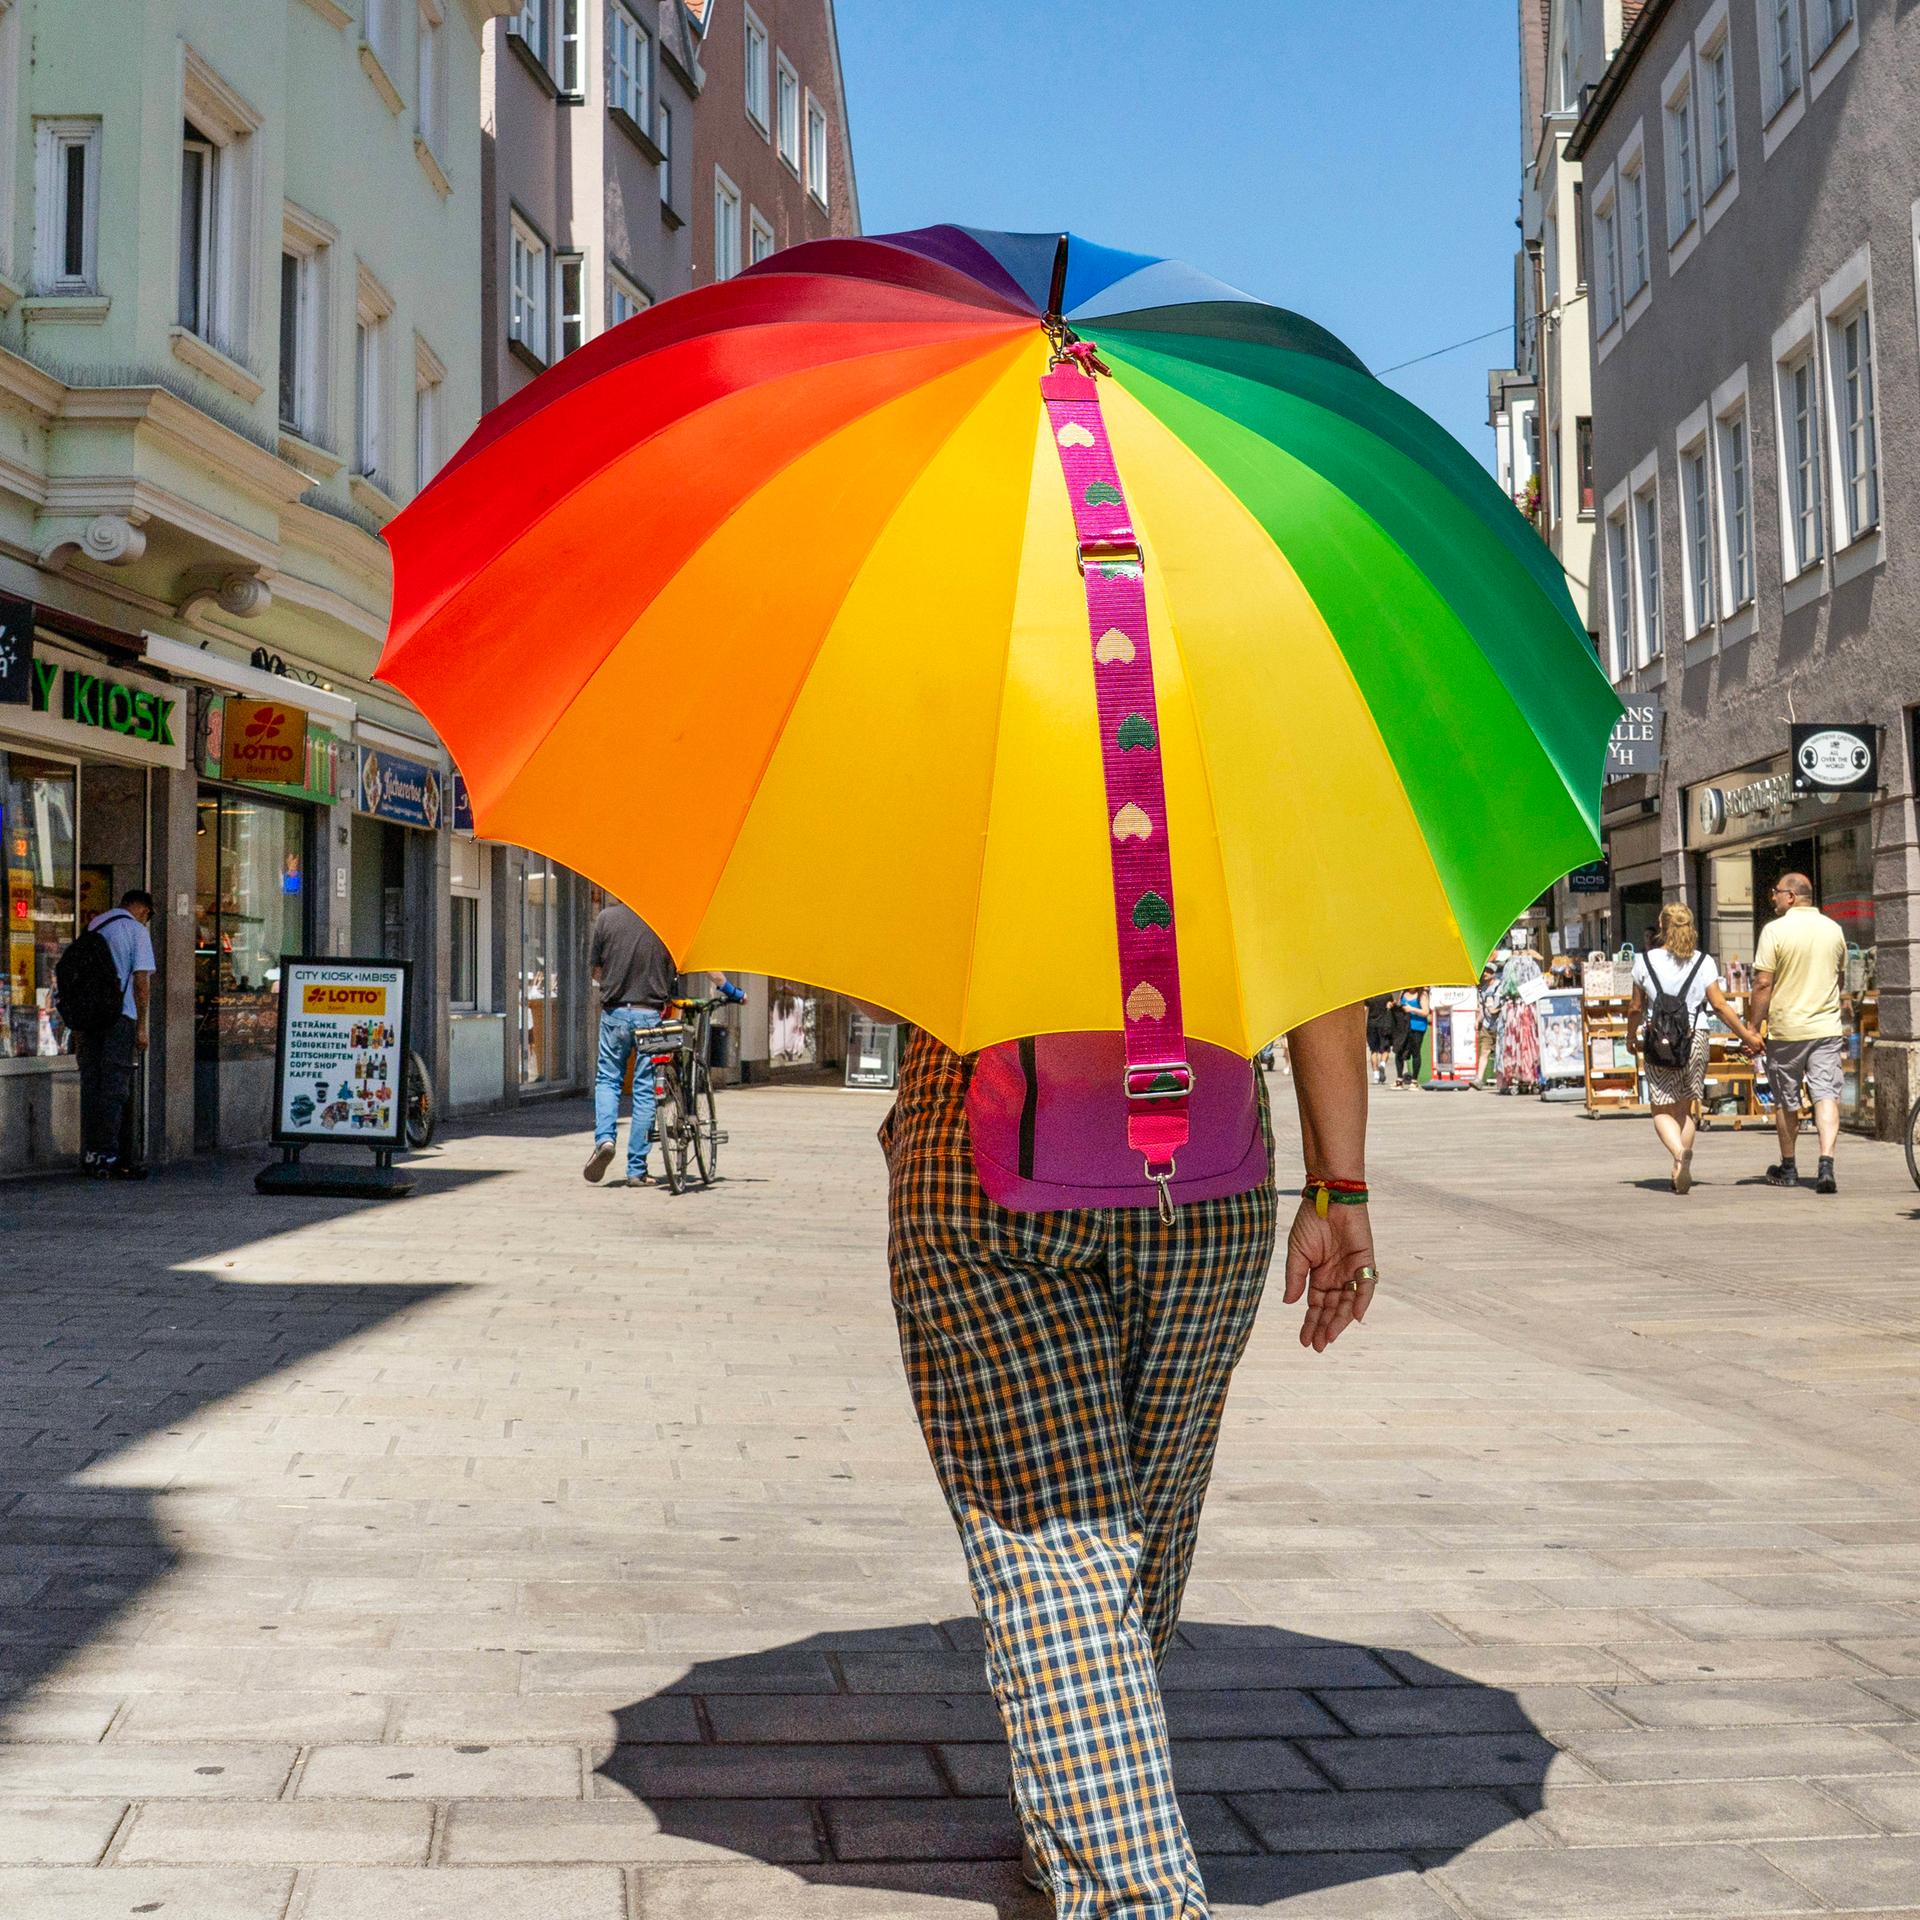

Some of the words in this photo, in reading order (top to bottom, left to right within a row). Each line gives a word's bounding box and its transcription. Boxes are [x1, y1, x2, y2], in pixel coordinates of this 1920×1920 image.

[65, 670, 175, 746] KIOSK
[1609, 724, 1654, 741] LLE
[233, 743, 294, 762] LOTTO
[295, 970, 319, 981] CITY
[321, 971, 353, 981] KIOSK
[359, 972, 397, 982] IMBISS
[329, 990, 378, 1003] LOTTO
[291, 1020, 337, 1029] GETRÄNKE
[291, 1031, 350, 1039] TABAKWAREN
[290, 1051, 354, 1060] ZEITSCHRIFTEN
